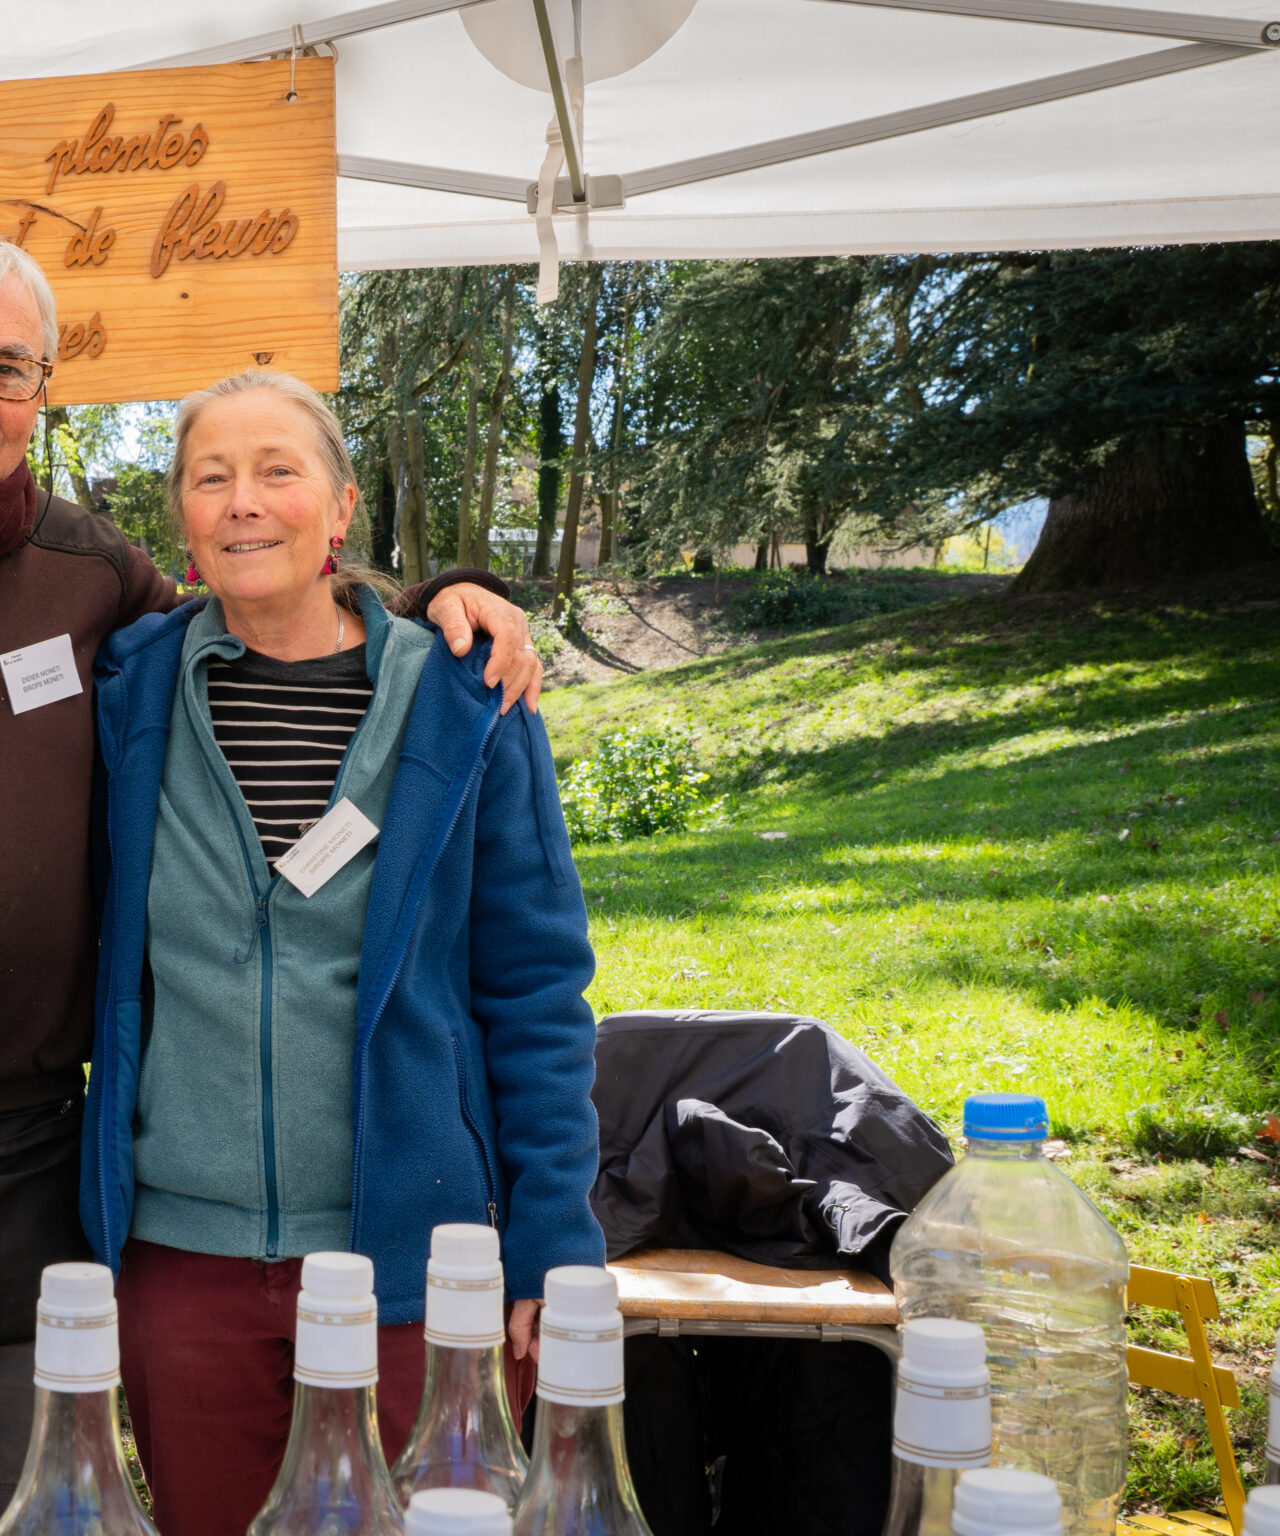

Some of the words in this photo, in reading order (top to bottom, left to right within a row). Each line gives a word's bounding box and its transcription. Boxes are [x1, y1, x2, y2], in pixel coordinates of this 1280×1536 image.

[44, 101, 210, 196] plantes
[63, 205, 118, 269] de
[150, 180, 300, 279] fleurs
